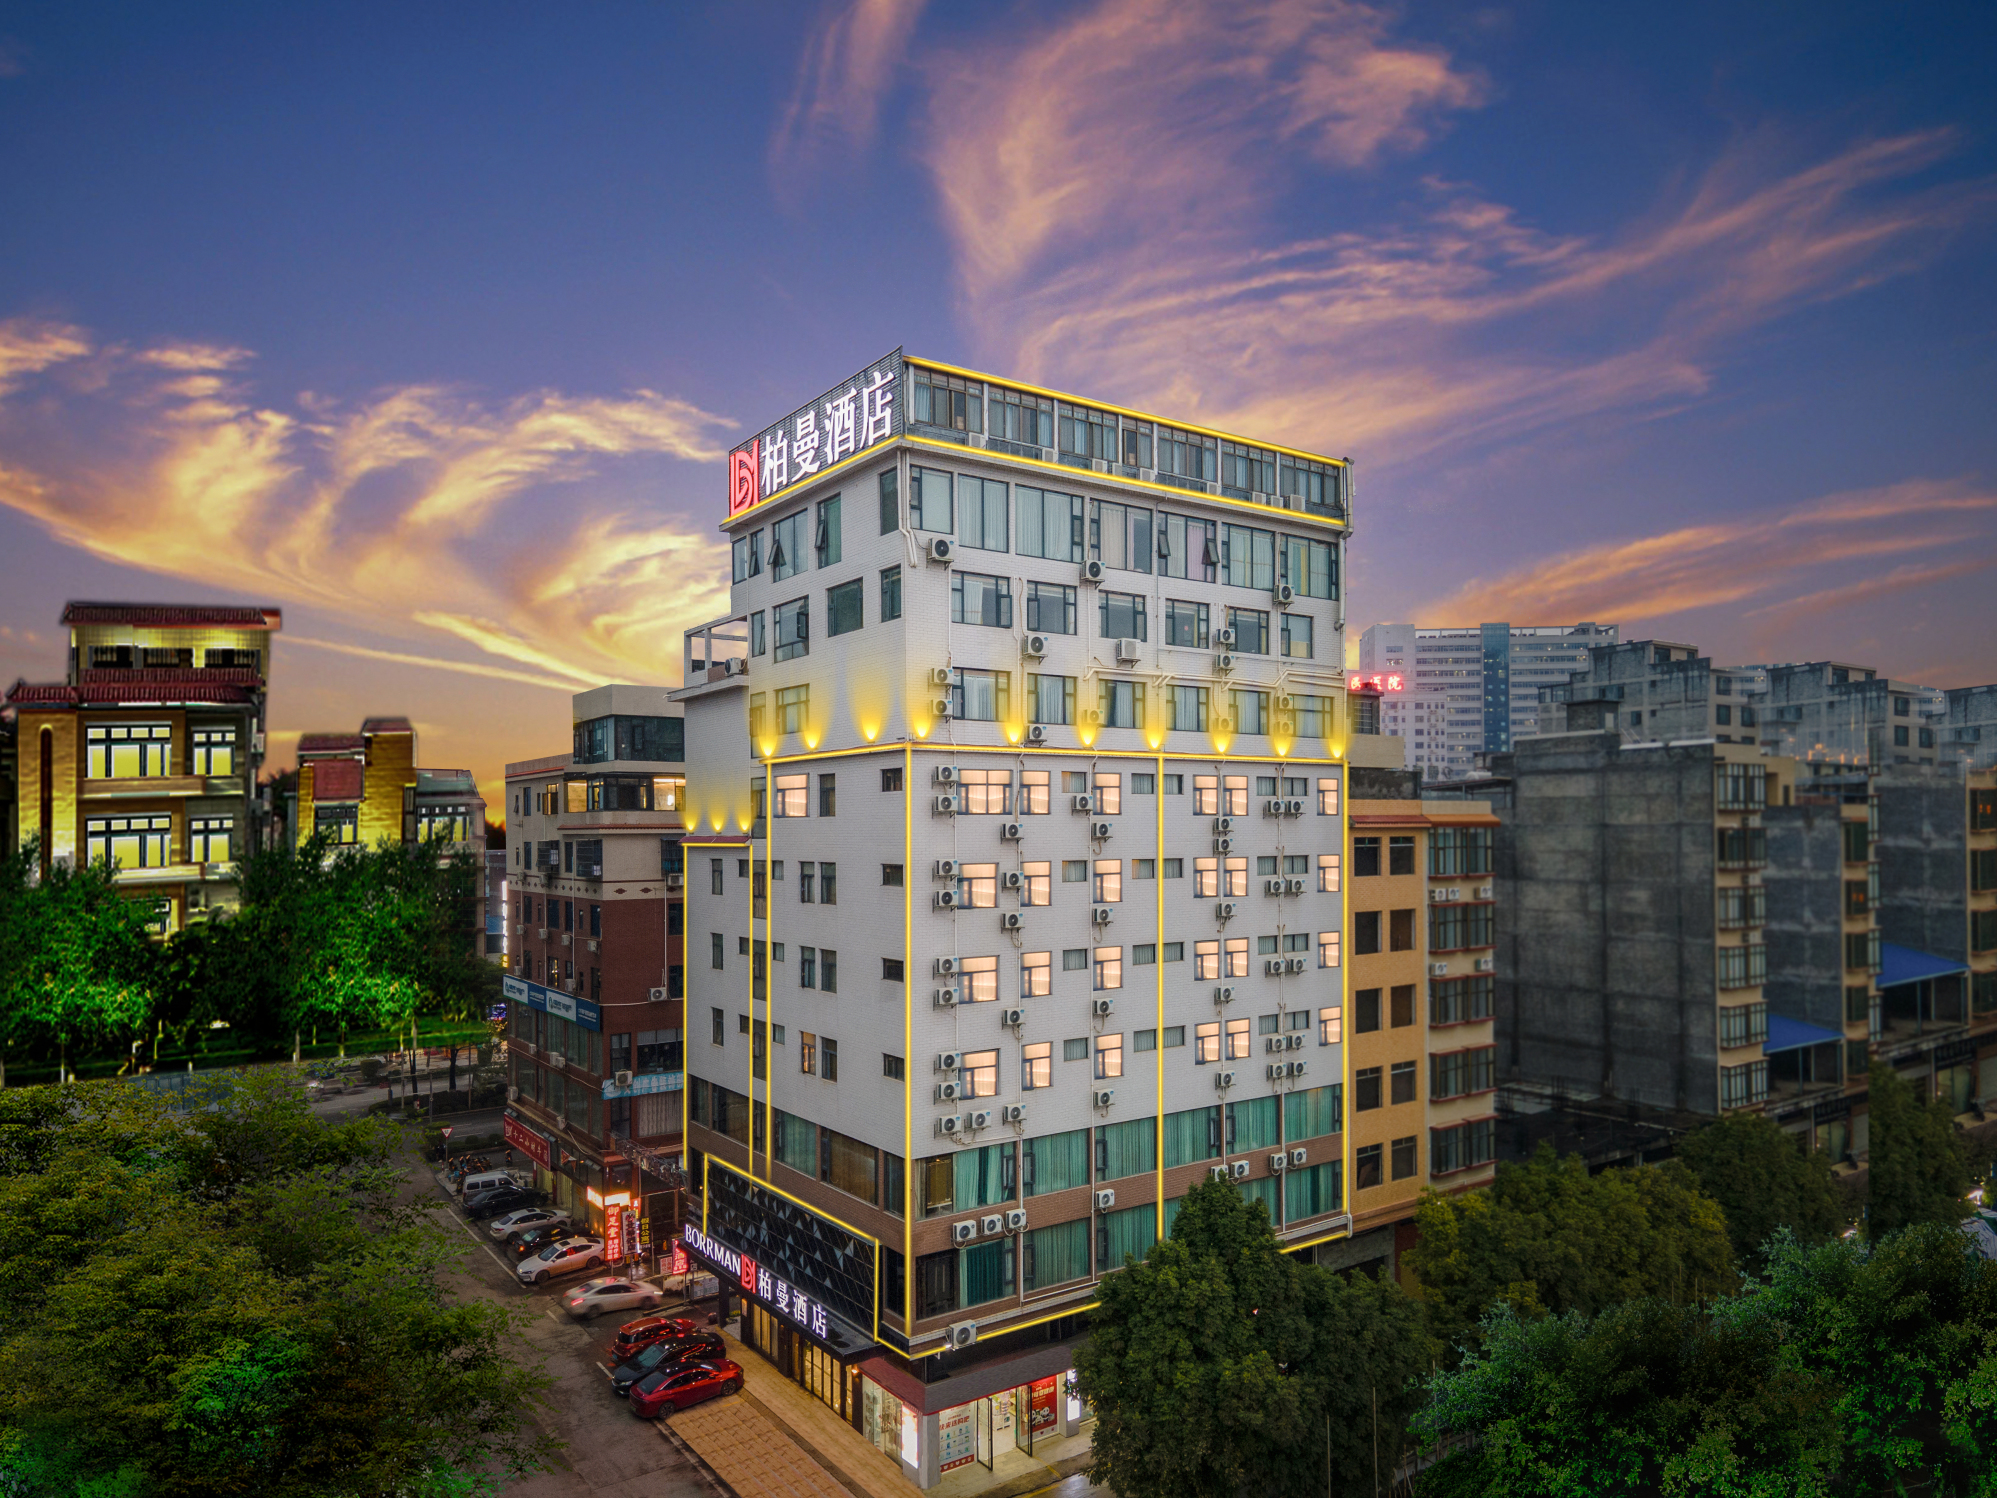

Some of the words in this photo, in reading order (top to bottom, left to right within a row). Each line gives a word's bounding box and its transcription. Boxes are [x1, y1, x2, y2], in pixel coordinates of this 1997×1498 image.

[761, 371, 894, 495] 柏曼酒店
[684, 1223, 742, 1277] BORRMAN
[757, 1267, 828, 1339] 柏曼酒店
